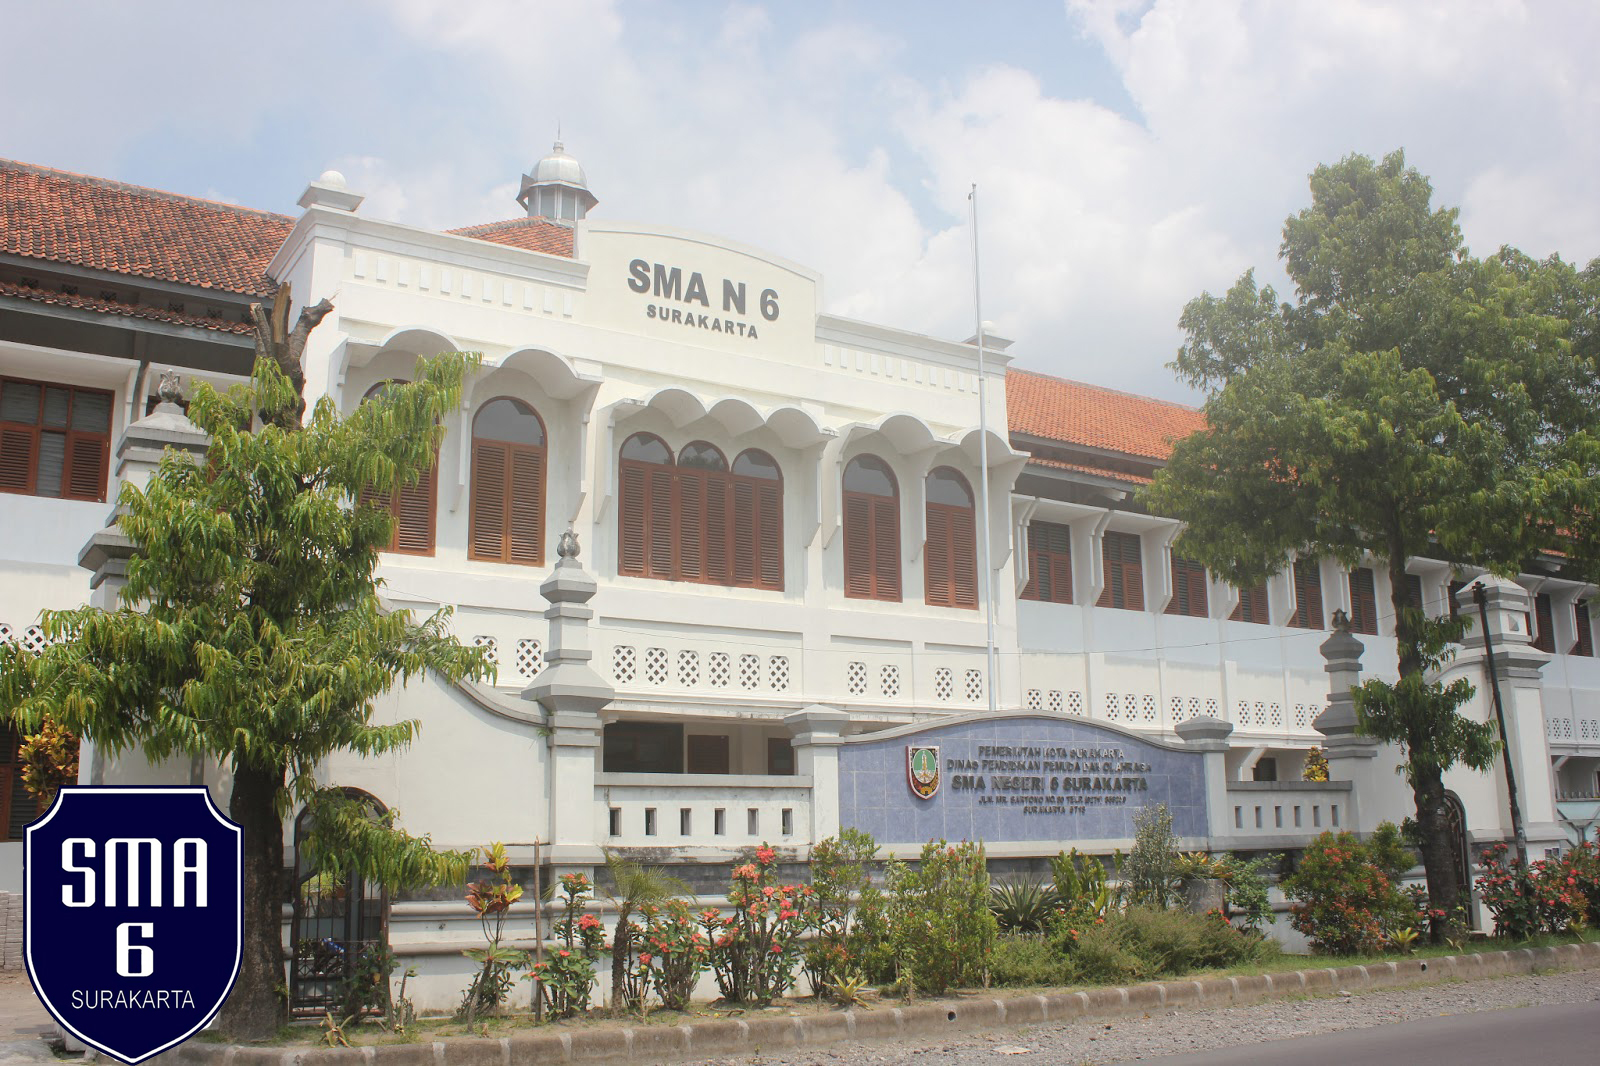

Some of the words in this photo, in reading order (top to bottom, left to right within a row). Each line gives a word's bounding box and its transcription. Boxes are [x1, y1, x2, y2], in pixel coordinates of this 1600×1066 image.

[628, 258, 709, 307] SMA
[722, 278, 746, 315] N
[759, 288, 780, 322] 6
[646, 304, 758, 339] SURAKARTA
[978, 746, 1041, 757] PEMERINTAH
[1043, 747, 1067, 758] KOTA
[1070, 748, 1124, 759] SURAKARTA
[946, 759, 979, 770] DINAS
[981, 760, 1041, 771] PENDIDIKAN
[1043, 761, 1080, 772] PEMUDA
[1083, 761, 1100, 772] DAN
[1102, 762, 1151, 773] OLAHRAGA
[951, 775, 986, 791] SMA
[991, 776, 1046, 791] NEGERI
[1049, 776, 1059, 791] 6
[1062, 776, 1149, 792] SURAKARTA
